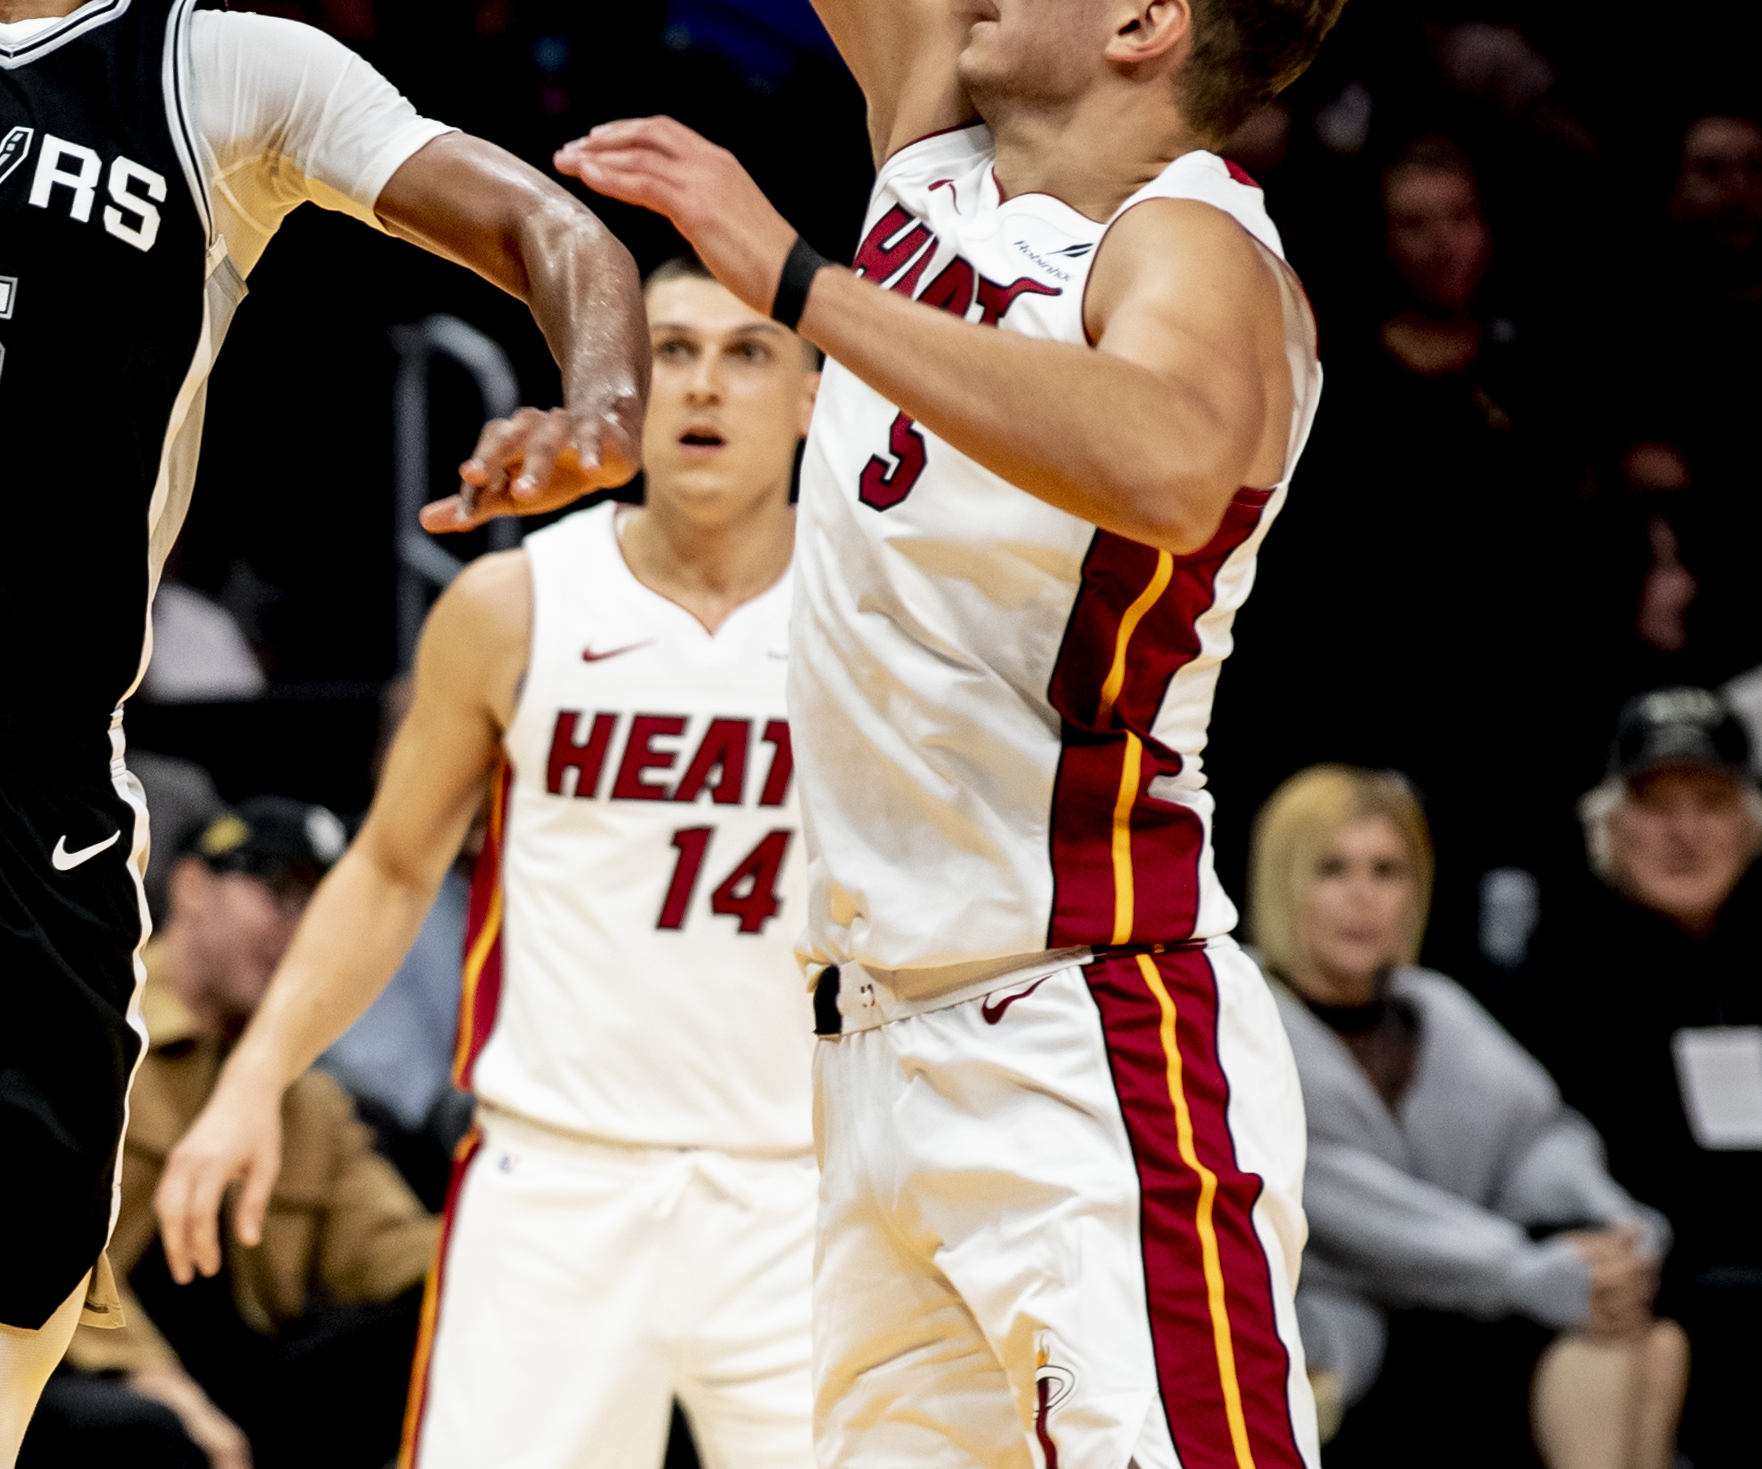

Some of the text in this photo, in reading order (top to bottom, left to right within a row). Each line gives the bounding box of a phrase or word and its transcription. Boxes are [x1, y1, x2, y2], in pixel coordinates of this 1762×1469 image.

[851, 201, 1063, 328] HAT
[545, 706, 796, 808] HEAT
[654, 825, 797, 936] 14
